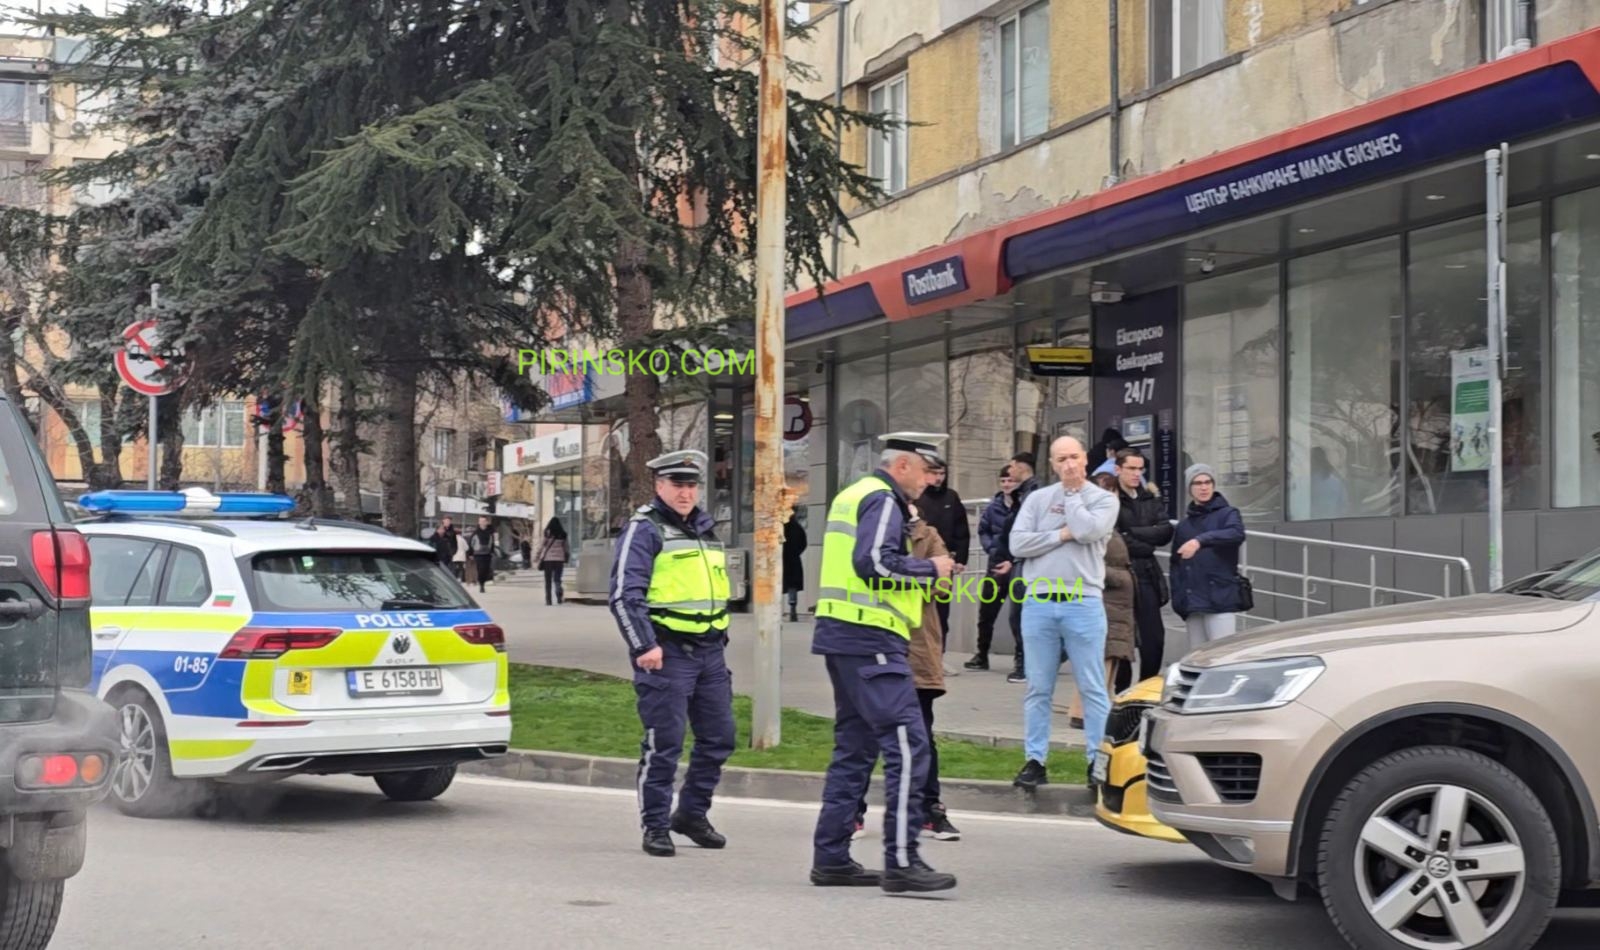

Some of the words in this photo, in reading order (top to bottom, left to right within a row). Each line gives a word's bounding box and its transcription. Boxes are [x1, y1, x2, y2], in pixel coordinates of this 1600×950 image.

[1185, 185, 1229, 213] ЦЕНТЪР
[1229, 164, 1300, 200] БАНКИРАНЕ
[1298, 150, 1348, 180] МАЛЪК
[1344, 133, 1402, 166] БИЗНЕС
[907, 262, 957, 297] Postbank
[1116, 325, 1164, 346] Експресно
[1116, 352, 1164, 371] банкиране
[1124, 378, 1155, 405] 24/7
[355, 613, 434, 628] POLICE
[174, 655, 209, 674] 01-85
[363, 672, 375, 689] E
[382, 671, 417, 688] 6158
[419, 670, 440, 688] HH
